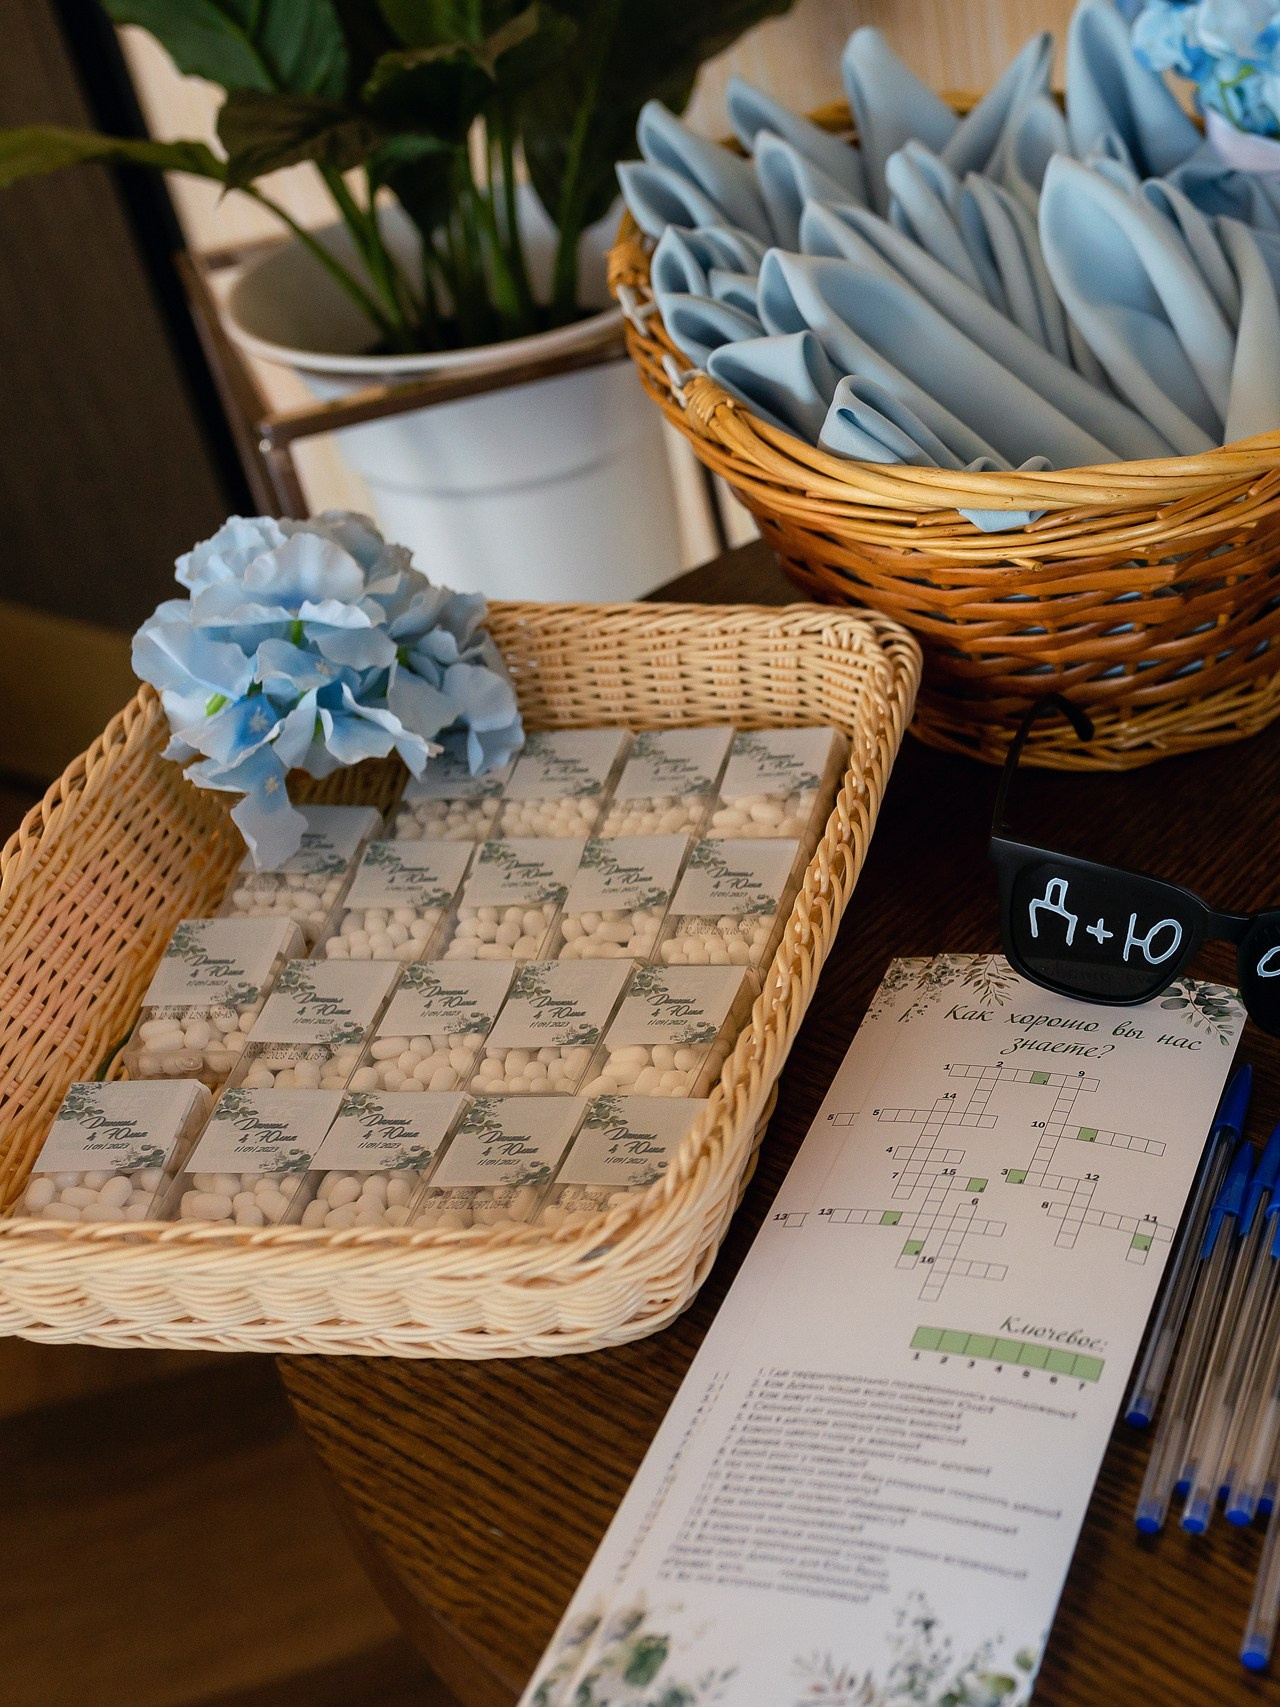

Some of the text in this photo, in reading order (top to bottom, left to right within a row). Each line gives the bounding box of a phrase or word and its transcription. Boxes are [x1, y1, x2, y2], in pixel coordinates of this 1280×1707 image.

[944, 1003, 1204, 1052] Как хорошо вы нас
[1000, 1036, 1116, 1059] знаете?
[942, 1092, 957, 1100] 14
[1030, 1120, 1046, 1129] 10
[941, 1168, 957, 1176] 15
[1084, 1173, 1100, 1181] 12
[818, 1207, 833, 1217] 13
[773, 1213, 788, 1222] 13
[1143, 1214, 1158, 1224] 11
[918, 1256, 935, 1265] 16
